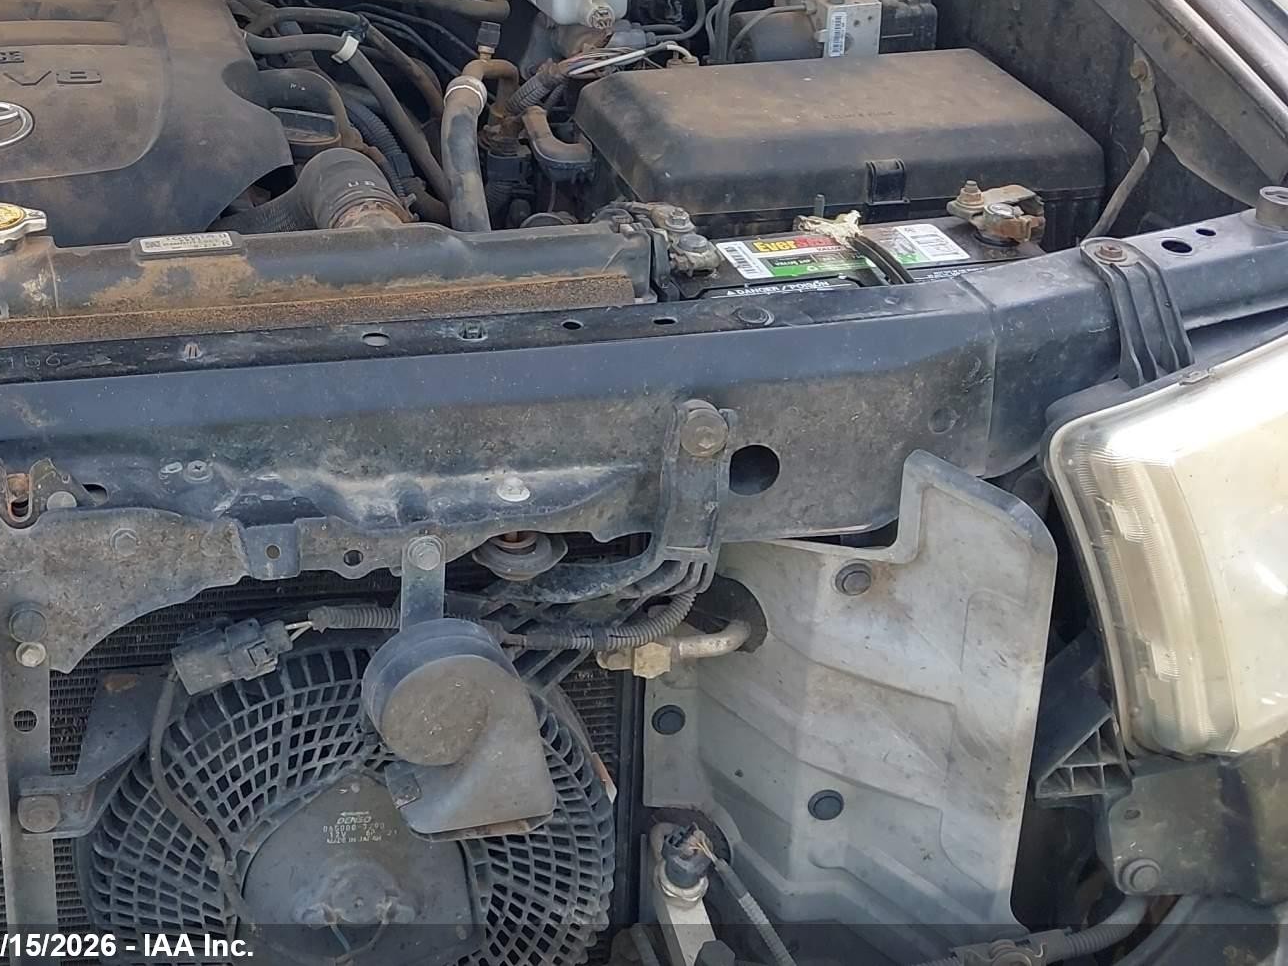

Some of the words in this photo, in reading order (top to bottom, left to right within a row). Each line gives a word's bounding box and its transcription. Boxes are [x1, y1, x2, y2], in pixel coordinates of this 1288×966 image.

[2, 69, 103, 87] V8
[736, 285, 780, 295] DANGER
[336, 815, 372, 825] DENSO
